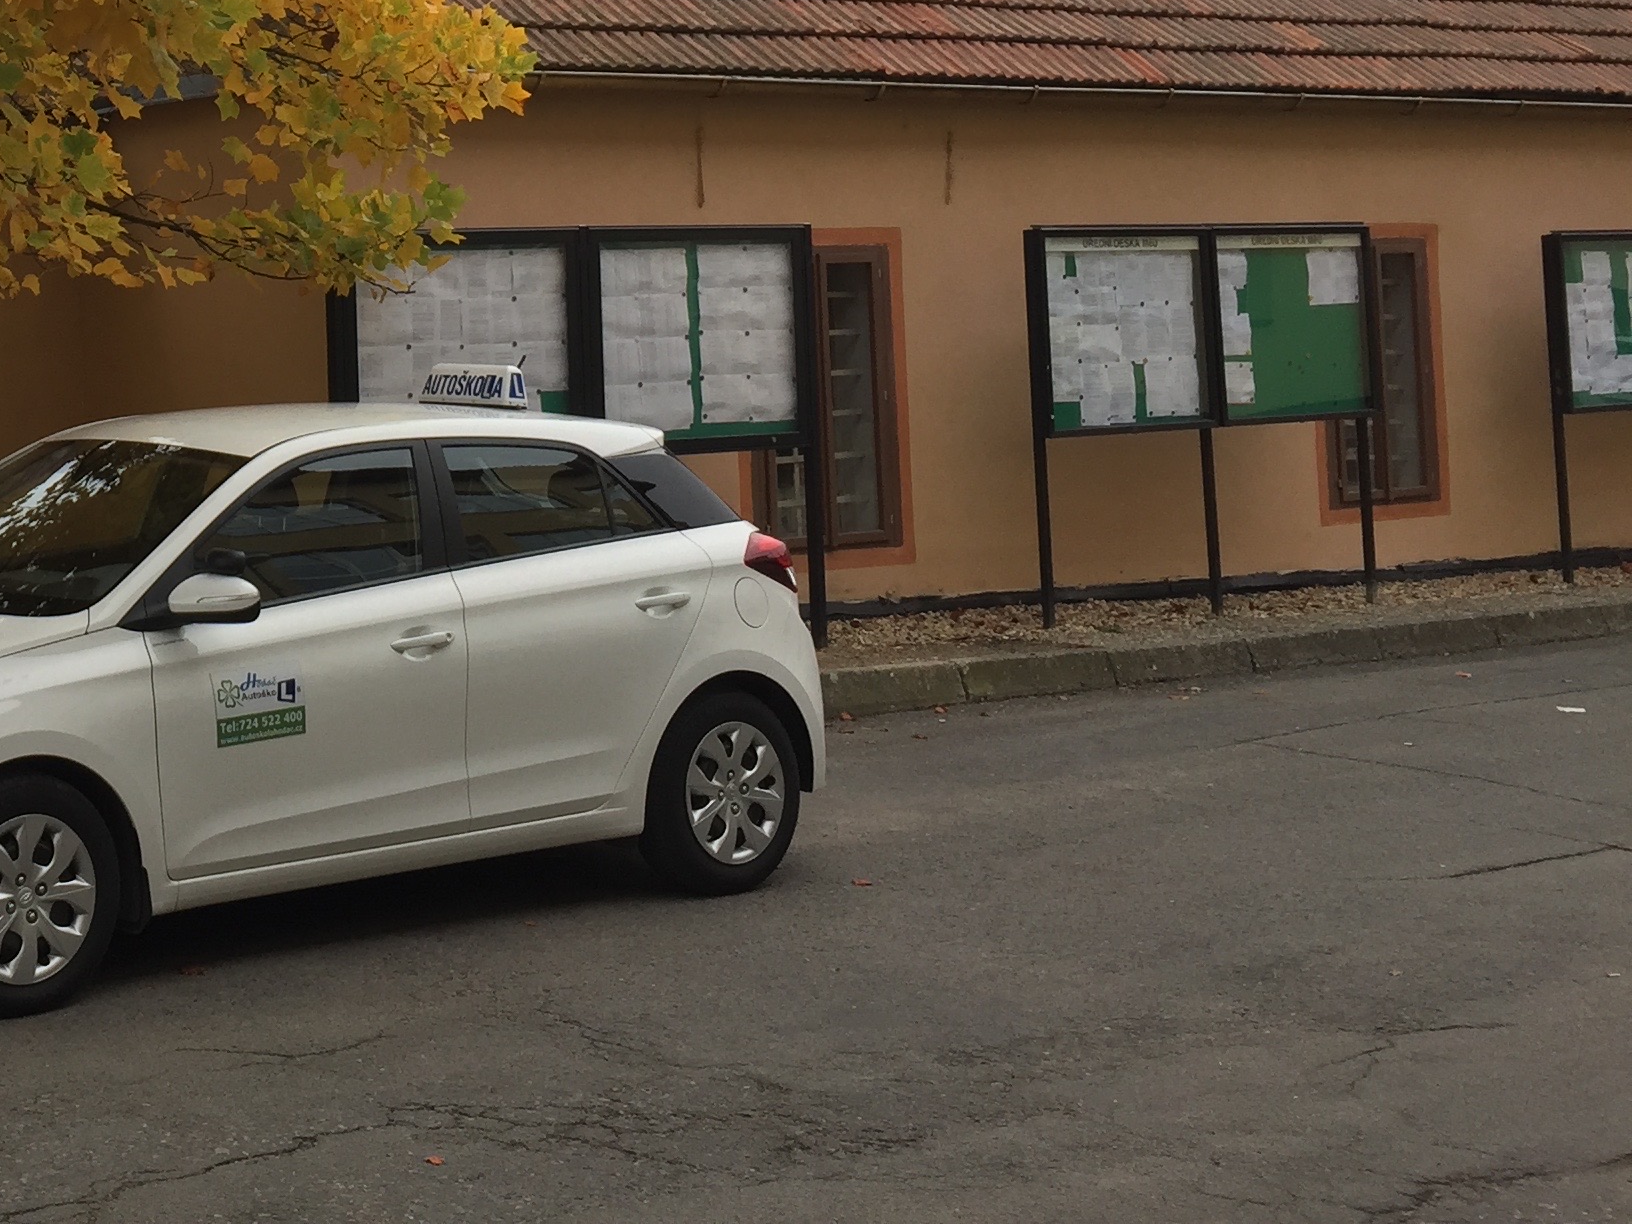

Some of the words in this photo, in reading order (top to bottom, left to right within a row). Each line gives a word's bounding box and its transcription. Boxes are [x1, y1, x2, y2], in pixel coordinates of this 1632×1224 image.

[421, 370, 504, 400] AUTOŠKOLA
[261, 713, 281, 727] 522
[283, 710, 303, 724] 400
